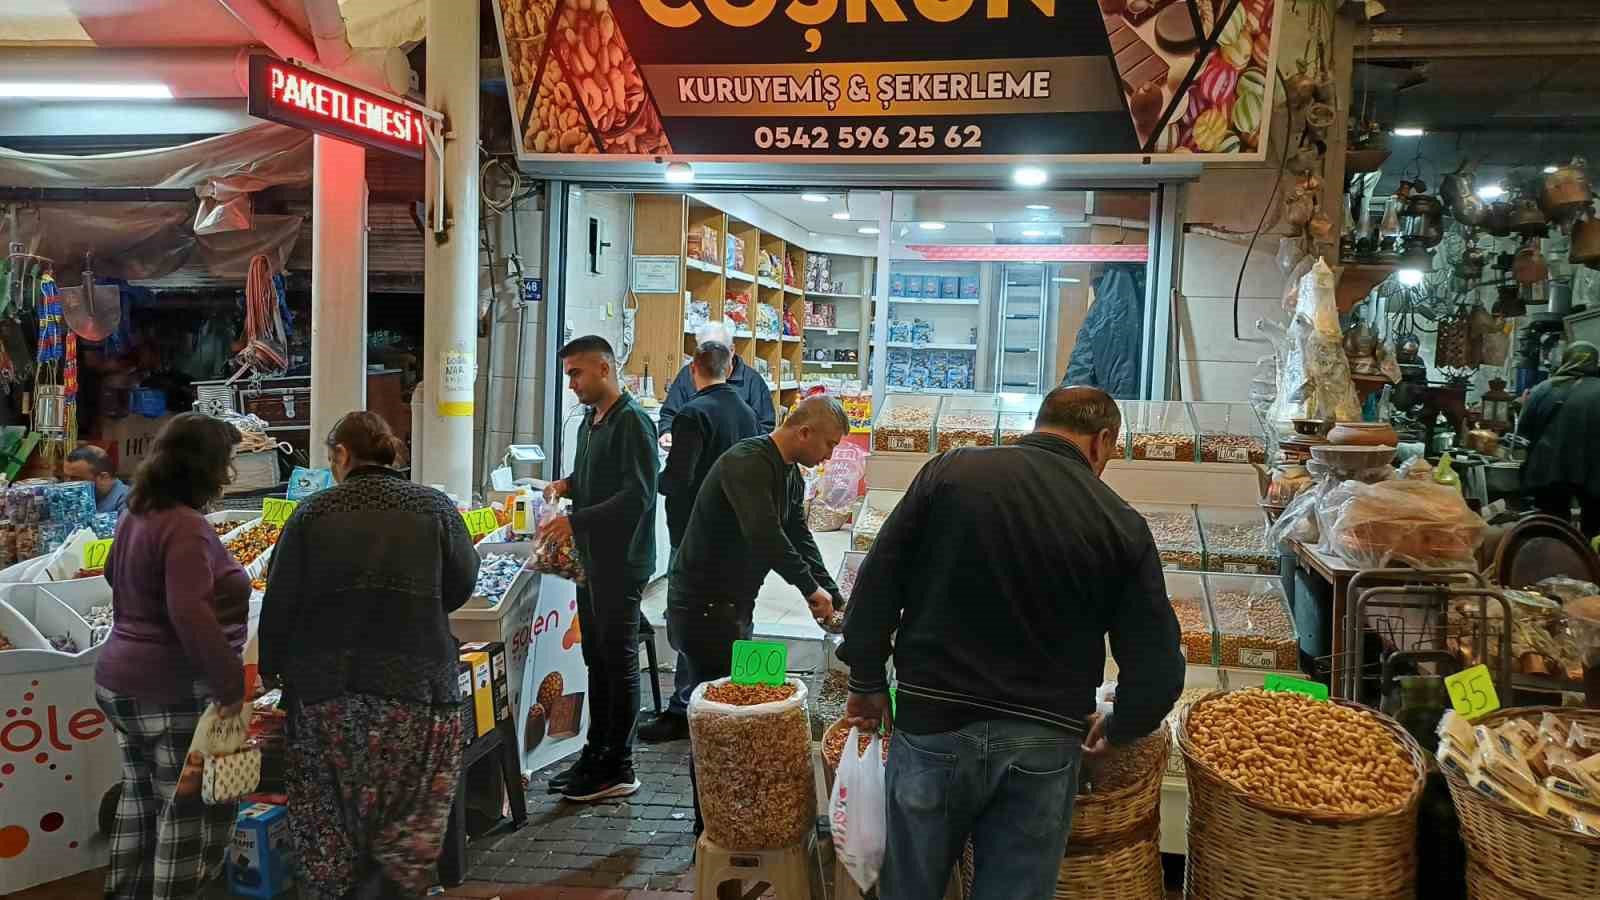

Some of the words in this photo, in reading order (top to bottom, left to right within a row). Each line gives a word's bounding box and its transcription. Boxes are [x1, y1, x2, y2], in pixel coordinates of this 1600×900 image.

[271, 68, 411, 141] PAKETLEMESİ
[678, 70, 840, 110] KURUYEMİŞ
[847, 77, 870, 101] &
[878, 71, 1051, 109] ŞEKERLEME
[754, 127, 829, 149] 0542
[838, 126, 890, 149] 596
[899, 126, 935, 149] 25
[944, 125, 982, 148] 62
[264, 502, 294, 522] 220
[466, 511, 496, 533] 170
[734, 646, 783, 677] 600
[1450, 675, 1488, 716] 35
